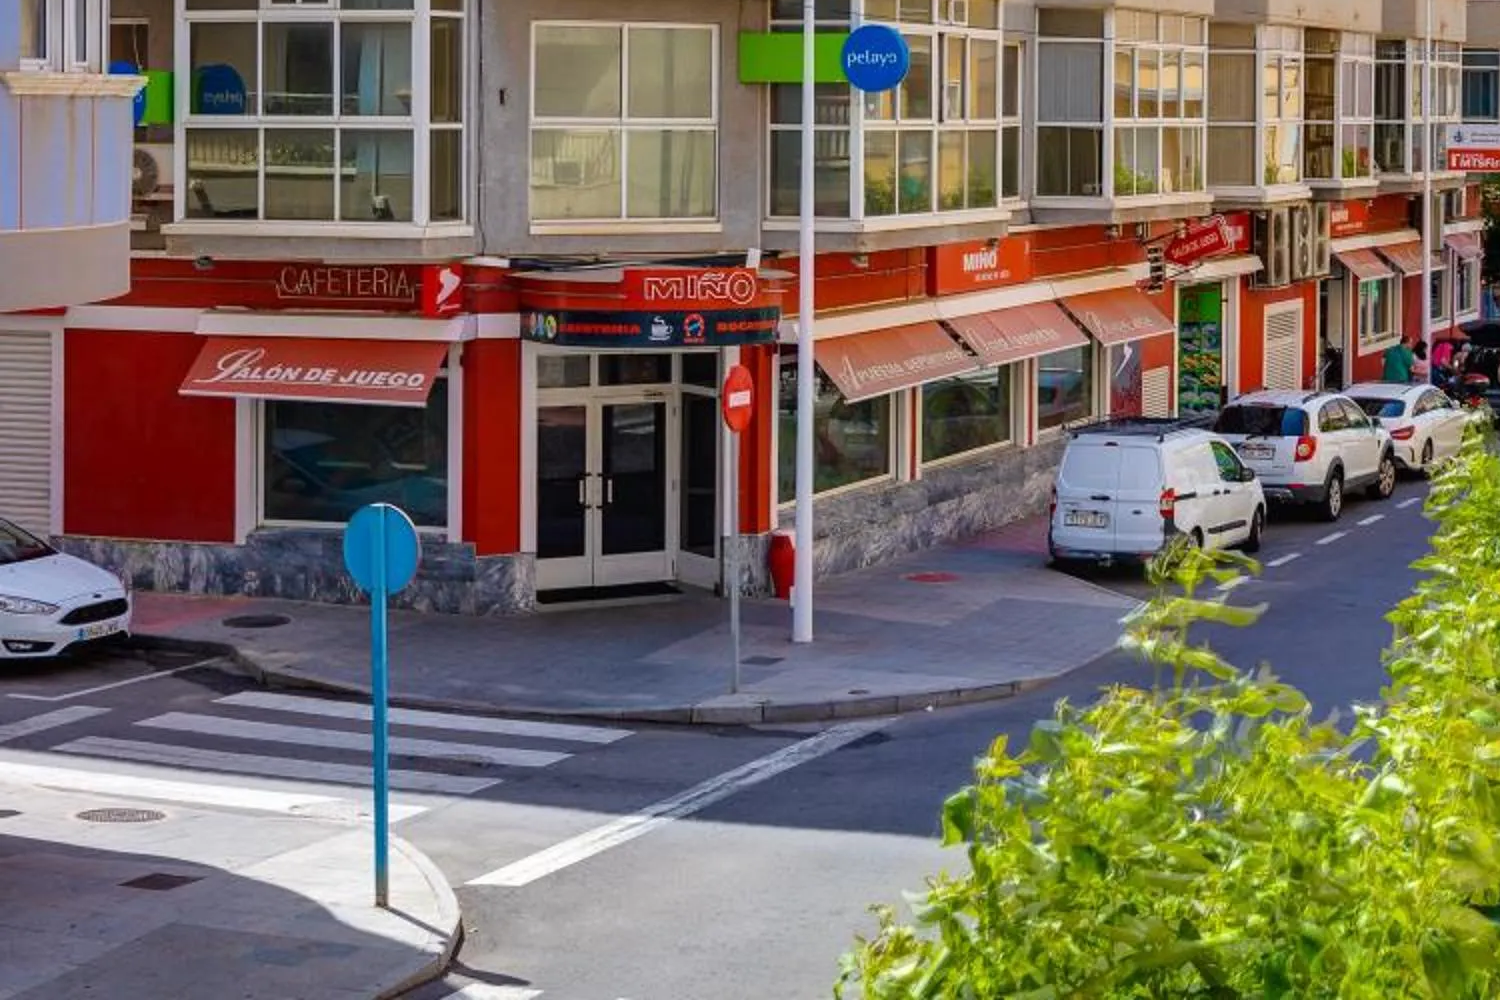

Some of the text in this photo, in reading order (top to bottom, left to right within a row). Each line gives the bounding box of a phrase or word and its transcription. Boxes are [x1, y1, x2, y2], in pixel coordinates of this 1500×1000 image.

[847, 49, 897, 68] pelayo
[278, 265, 410, 296] CAFETERIA
[643, 271, 756, 305] MIÑO
[198, 348, 425, 388] SALÓN DE JUEGO
